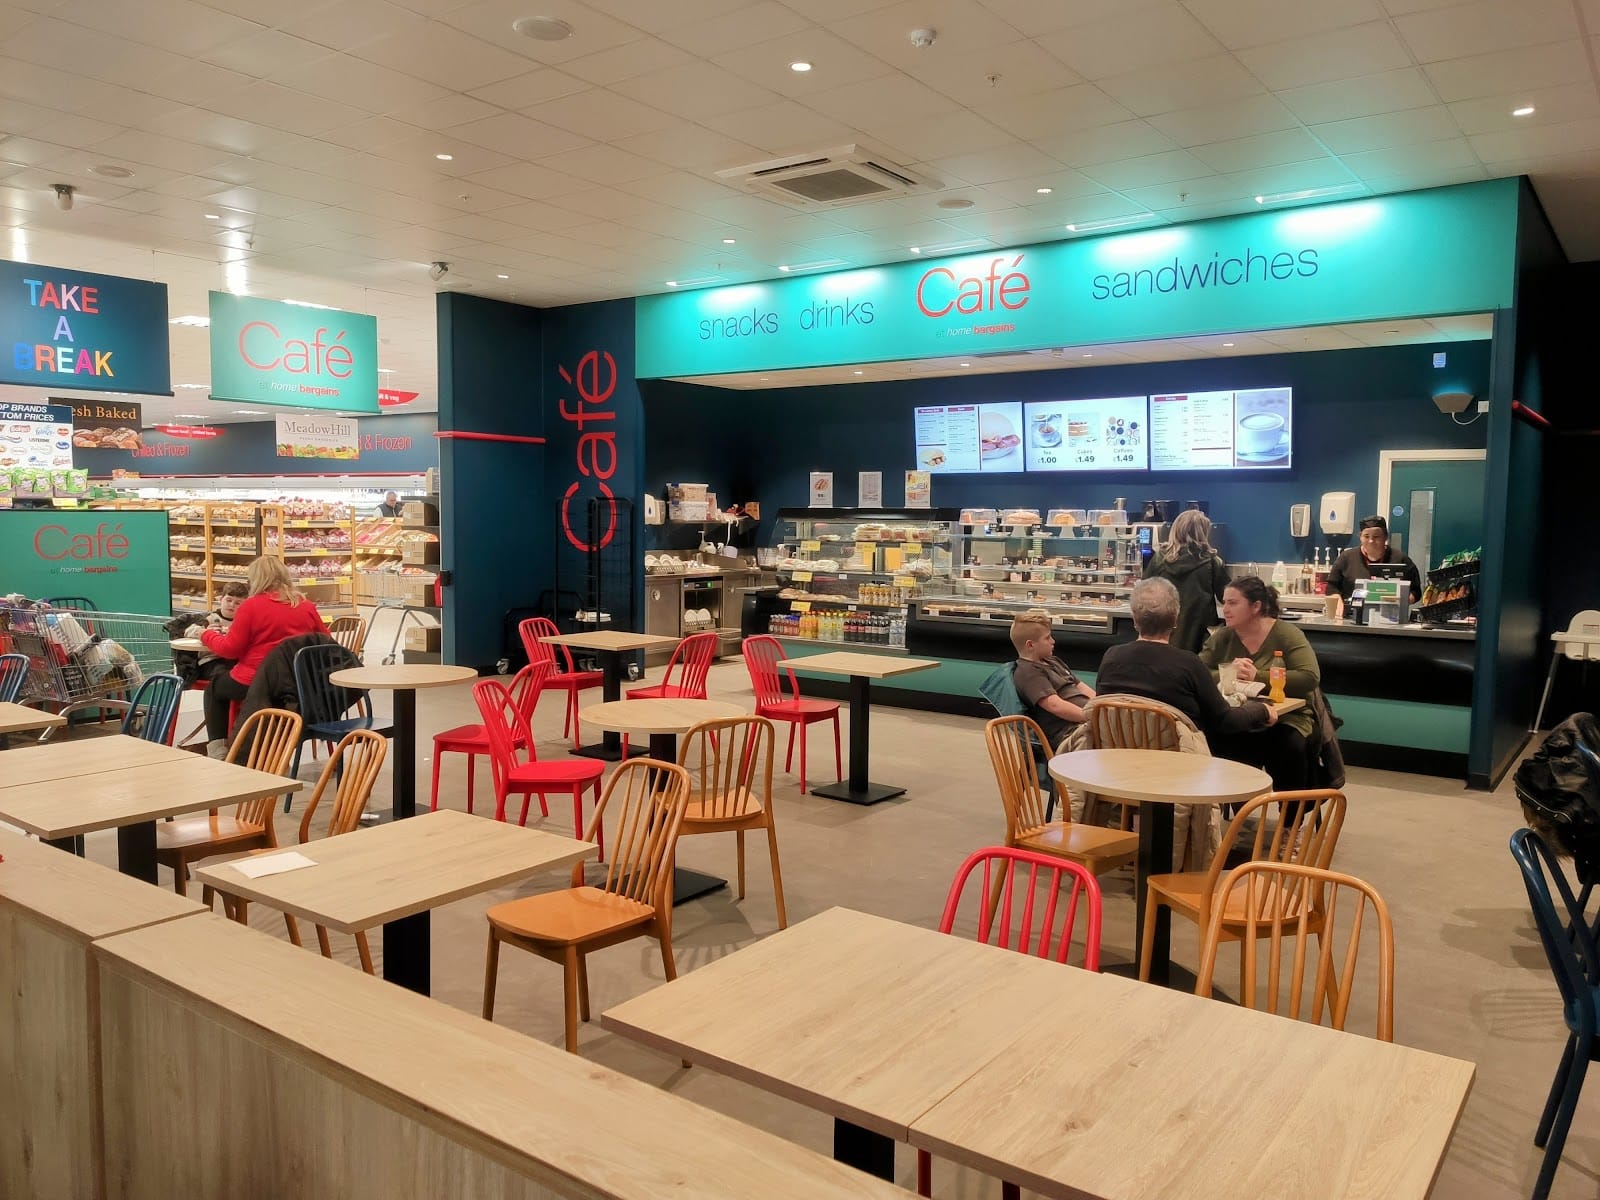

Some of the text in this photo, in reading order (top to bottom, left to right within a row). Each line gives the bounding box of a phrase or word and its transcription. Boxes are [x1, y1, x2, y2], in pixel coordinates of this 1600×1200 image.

[1092, 247, 1319, 300] sandwiches
[23, 278, 99, 314] TAKE
[916, 253, 1031, 318] Café
[53, 315, 75, 342] A
[699, 297, 875, 341] snacks drinks
[947, 327, 972, 337] home
[973, 323, 1016, 336] bargains
[14, 342, 114, 377] BREAK
[238, 320, 354, 379] Café
[270, 381, 297, 392] home
[298, 384, 340, 397] bargains
[0, 411, 55, 422] TOM PRICES
[11, 403, 48, 413] BRANDS
[72, 404, 137, 420] esh Baked
[284, 421, 351, 436] MeadowHill
[163, 440, 190, 457] Frozen
[364, 434, 373, 450] &
[375, 433, 413, 450] Frozen
[558, 350, 617, 552] Café
[34, 522, 130, 561] Café
[60, 566, 82, 574] home
